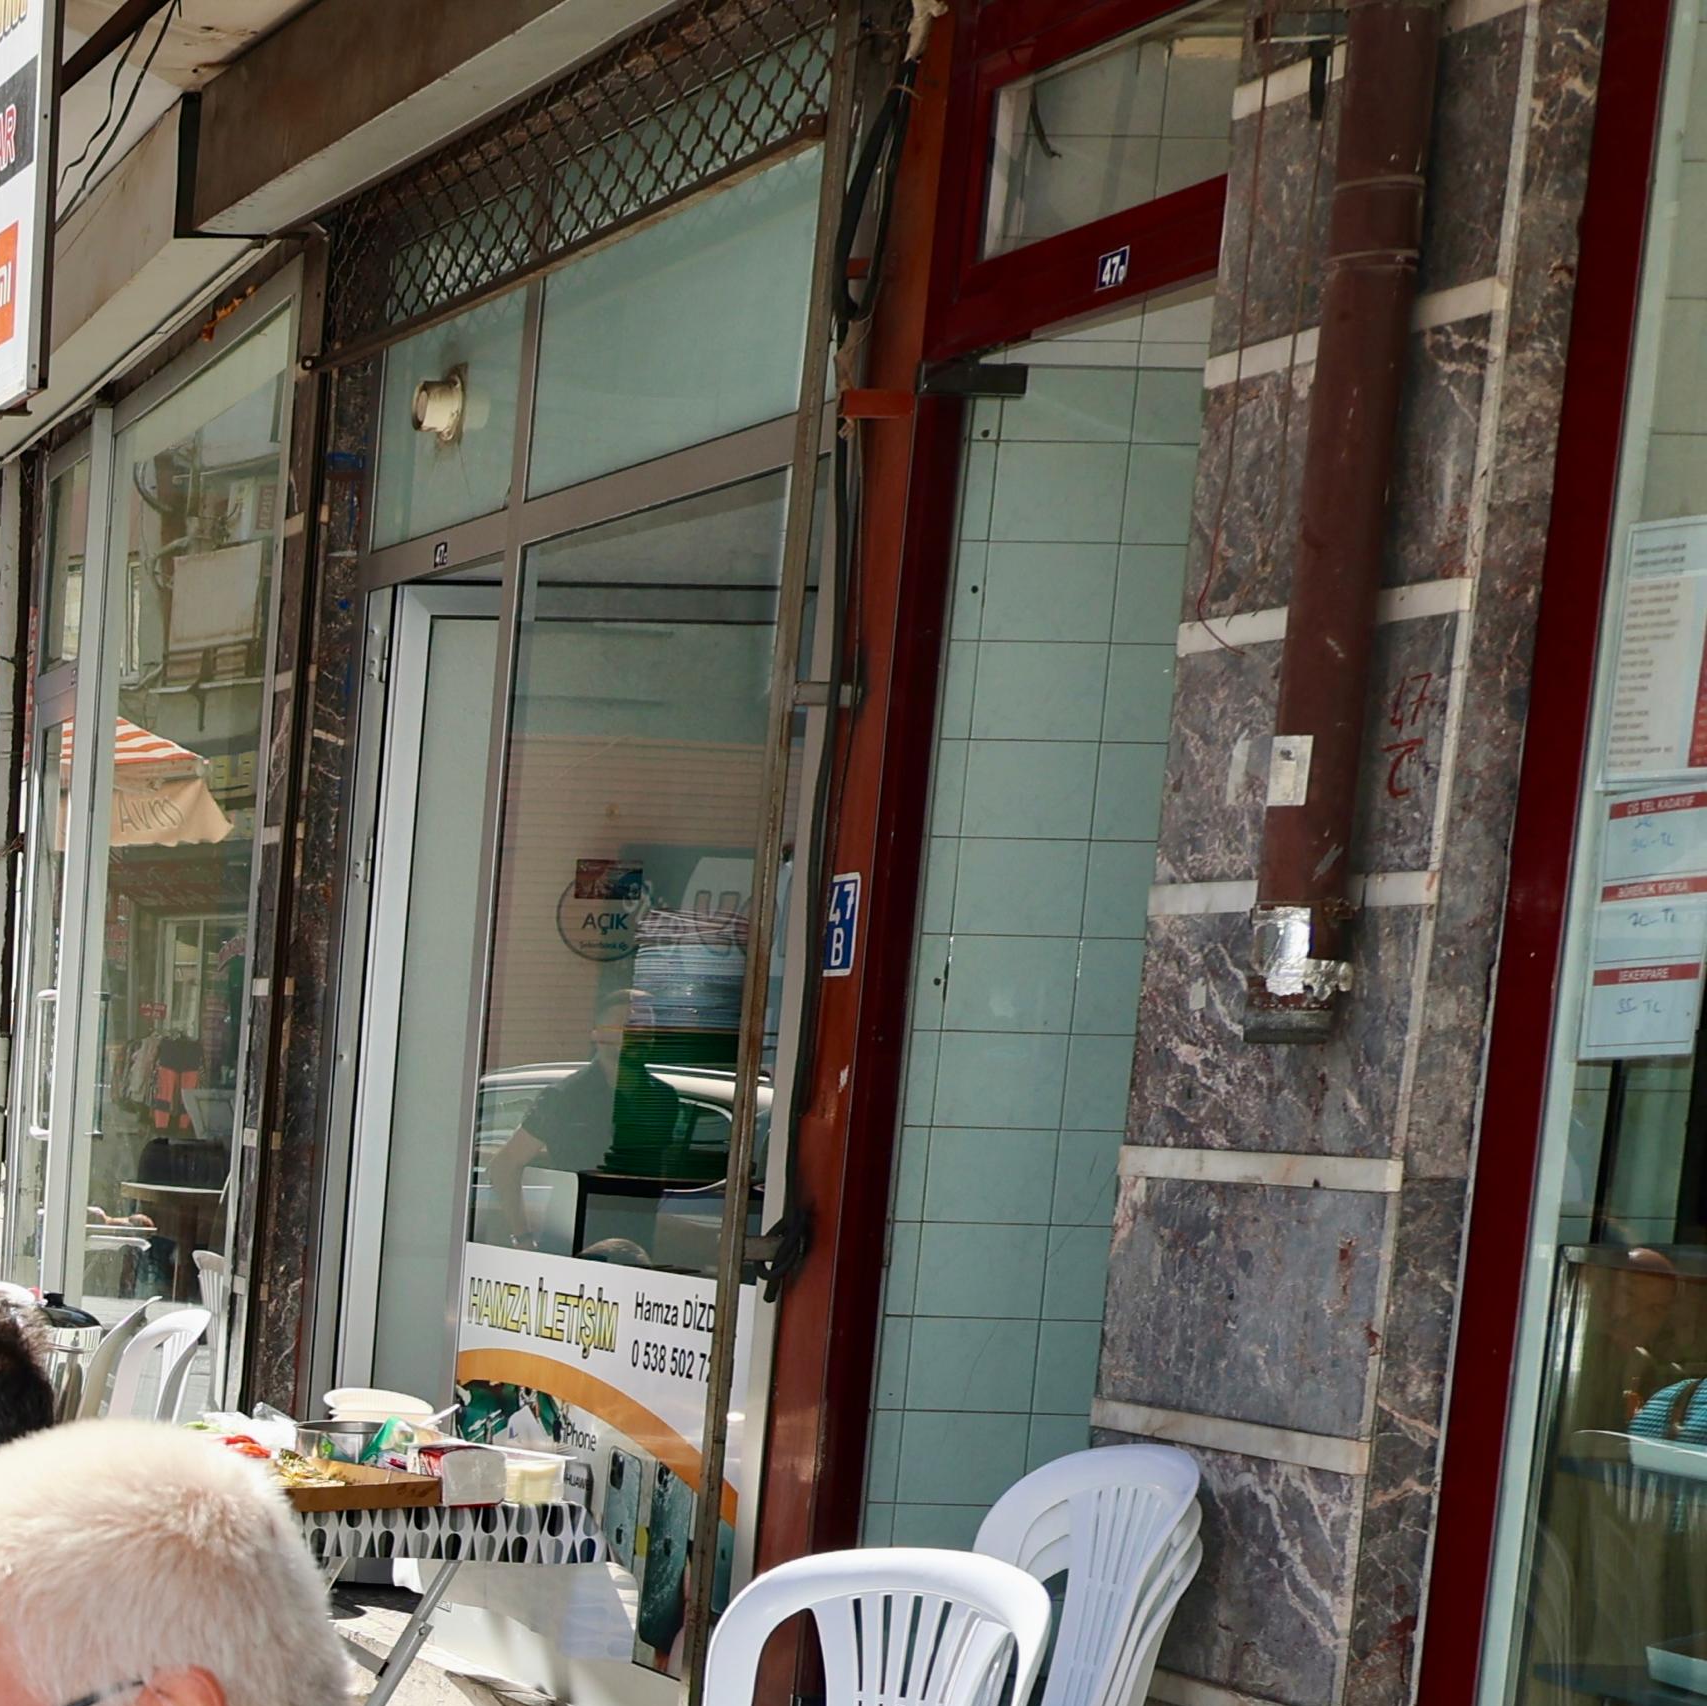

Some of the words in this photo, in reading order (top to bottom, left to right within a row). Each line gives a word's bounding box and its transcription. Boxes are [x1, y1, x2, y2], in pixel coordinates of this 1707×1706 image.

[1641, 800, 1655, 813] TEL
[582, 912, 628, 935] AÇIK
[828, 882, 856, 926] 47
[831, 928, 845, 967] B
[467, 1276, 531, 1336] HAMZA
[535, 1276, 620, 1359] İLETİŞİM
[634, 1290, 679, 1326] Hamza
[683, 1293, 716, 1333] DİZD
[631, 1338, 639, 1369] 0
[643, 1342, 666, 1373] 538
[670, 1347, 694, 1380] 502
[563, 1416, 597, 1452] iPhone
